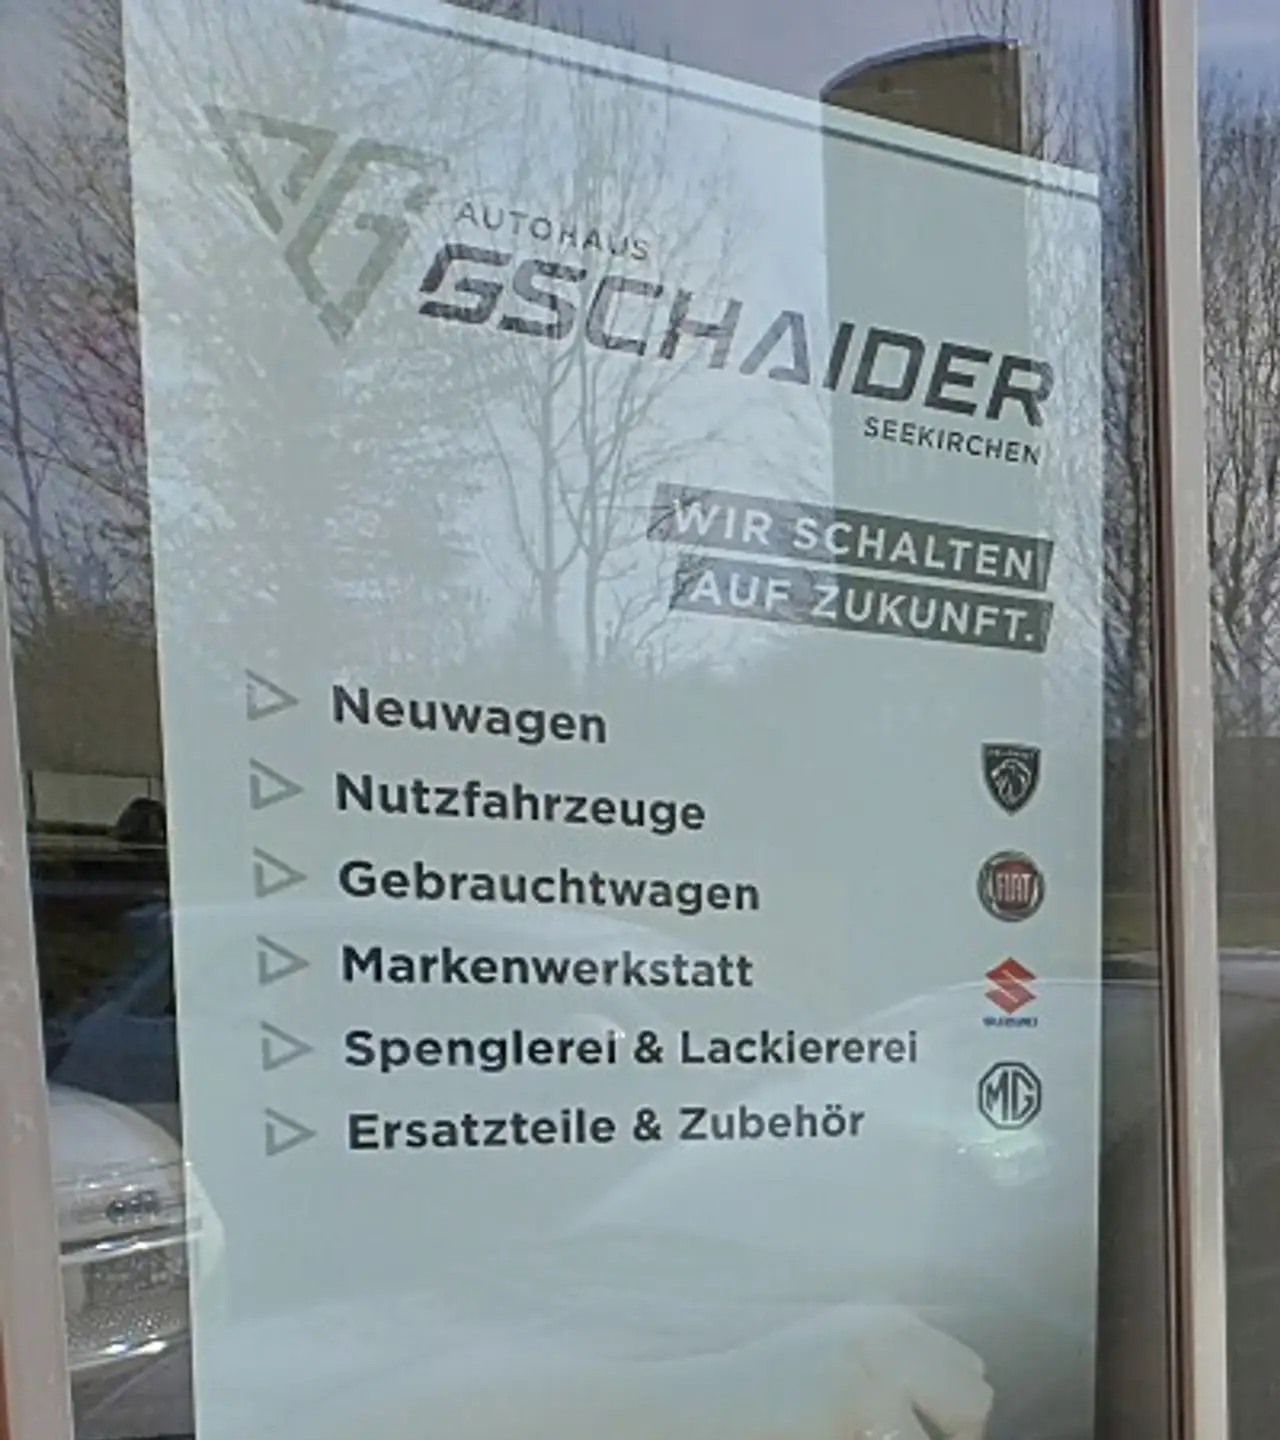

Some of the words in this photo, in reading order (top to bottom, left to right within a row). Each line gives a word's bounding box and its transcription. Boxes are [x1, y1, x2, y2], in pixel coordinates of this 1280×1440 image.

[454, 201, 650, 261] AUTOHAUS
[419, 243, 1055, 428] GSCHAIDER
[864, 416, 1042, 466] SEEKIRCHEN
[672, 498, 774, 546] WIR
[792, 517, 1034, 581] SCHALTEN
[690, 570, 792, 611] AUF
[810, 583, 1035, 643] ZUKUNFT.
[332, 684, 608, 746] Neuwagen
[335, 771, 706, 836] Nutzfahrzeuge
[338, 859, 761, 917] Gebrauchtwagen
[341, 944, 754, 988] Markenwerkstatt
[343, 1029, 618, 1074] Spenglerei
[632, 1029, 665, 1065] &
[680, 1029, 919, 1065] Lackiererei
[985, 1068, 1035, 1123] MG
[348, 1108, 616, 1150] Ersatzteile
[631, 1106, 663, 1143] &
[678, 1103, 867, 1142] Zubehör
